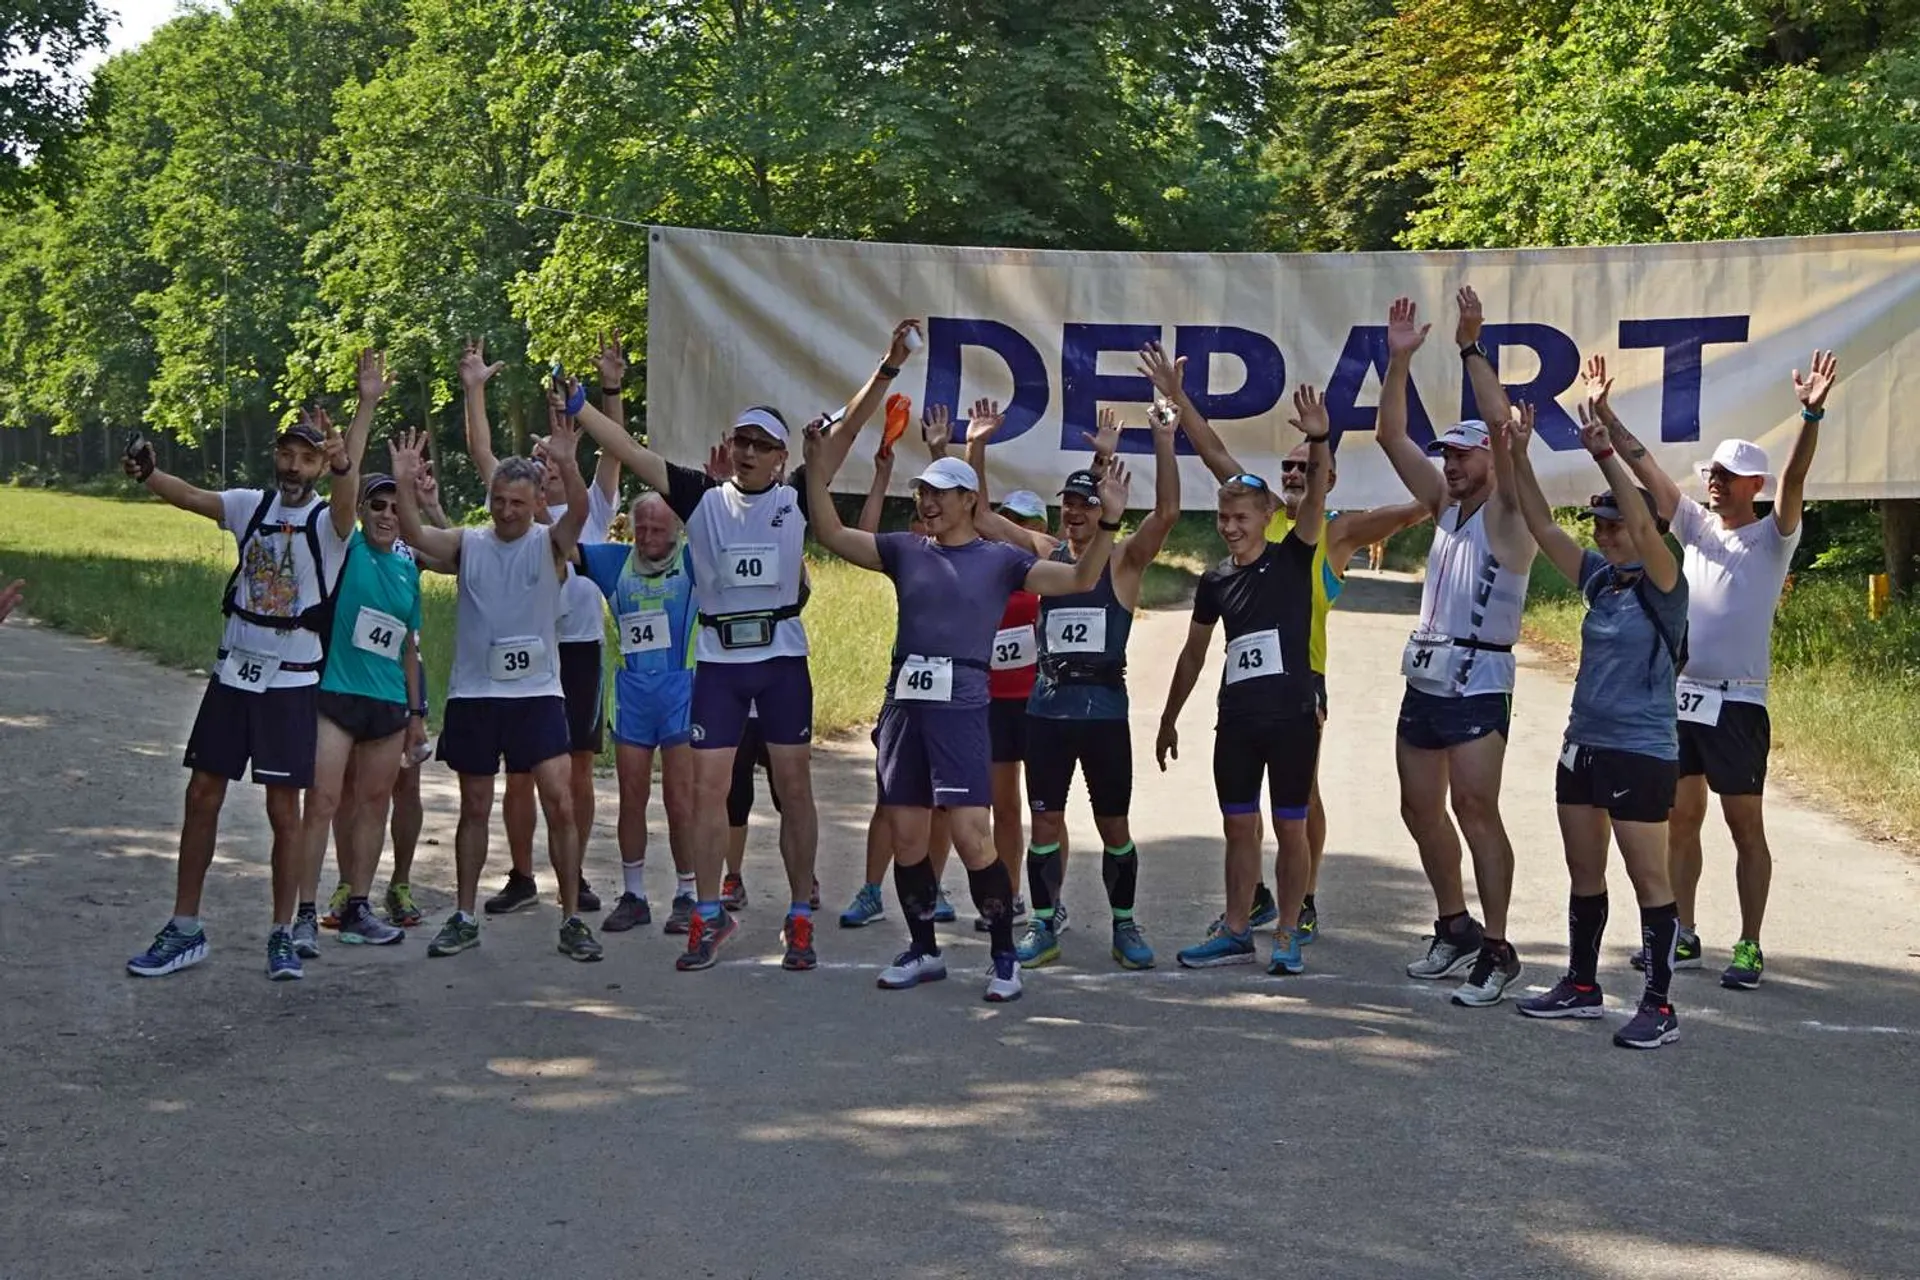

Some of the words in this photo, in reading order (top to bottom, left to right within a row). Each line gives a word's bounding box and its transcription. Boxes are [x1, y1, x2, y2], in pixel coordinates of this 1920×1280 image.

[922, 315, 1750, 457] DEPART
[735, 558, 762, 577] 40
[369, 626, 392, 648] 44
[631, 624, 654, 645] 34
[1061, 623, 1087, 643] 42
[504, 650, 530, 671] 39
[996, 642, 1021, 662] 32
[1239, 648, 1263, 669] 43
[237, 662, 262, 683] 45
[907, 670, 933, 690] 46
[1678, 692, 1704, 712] 37
